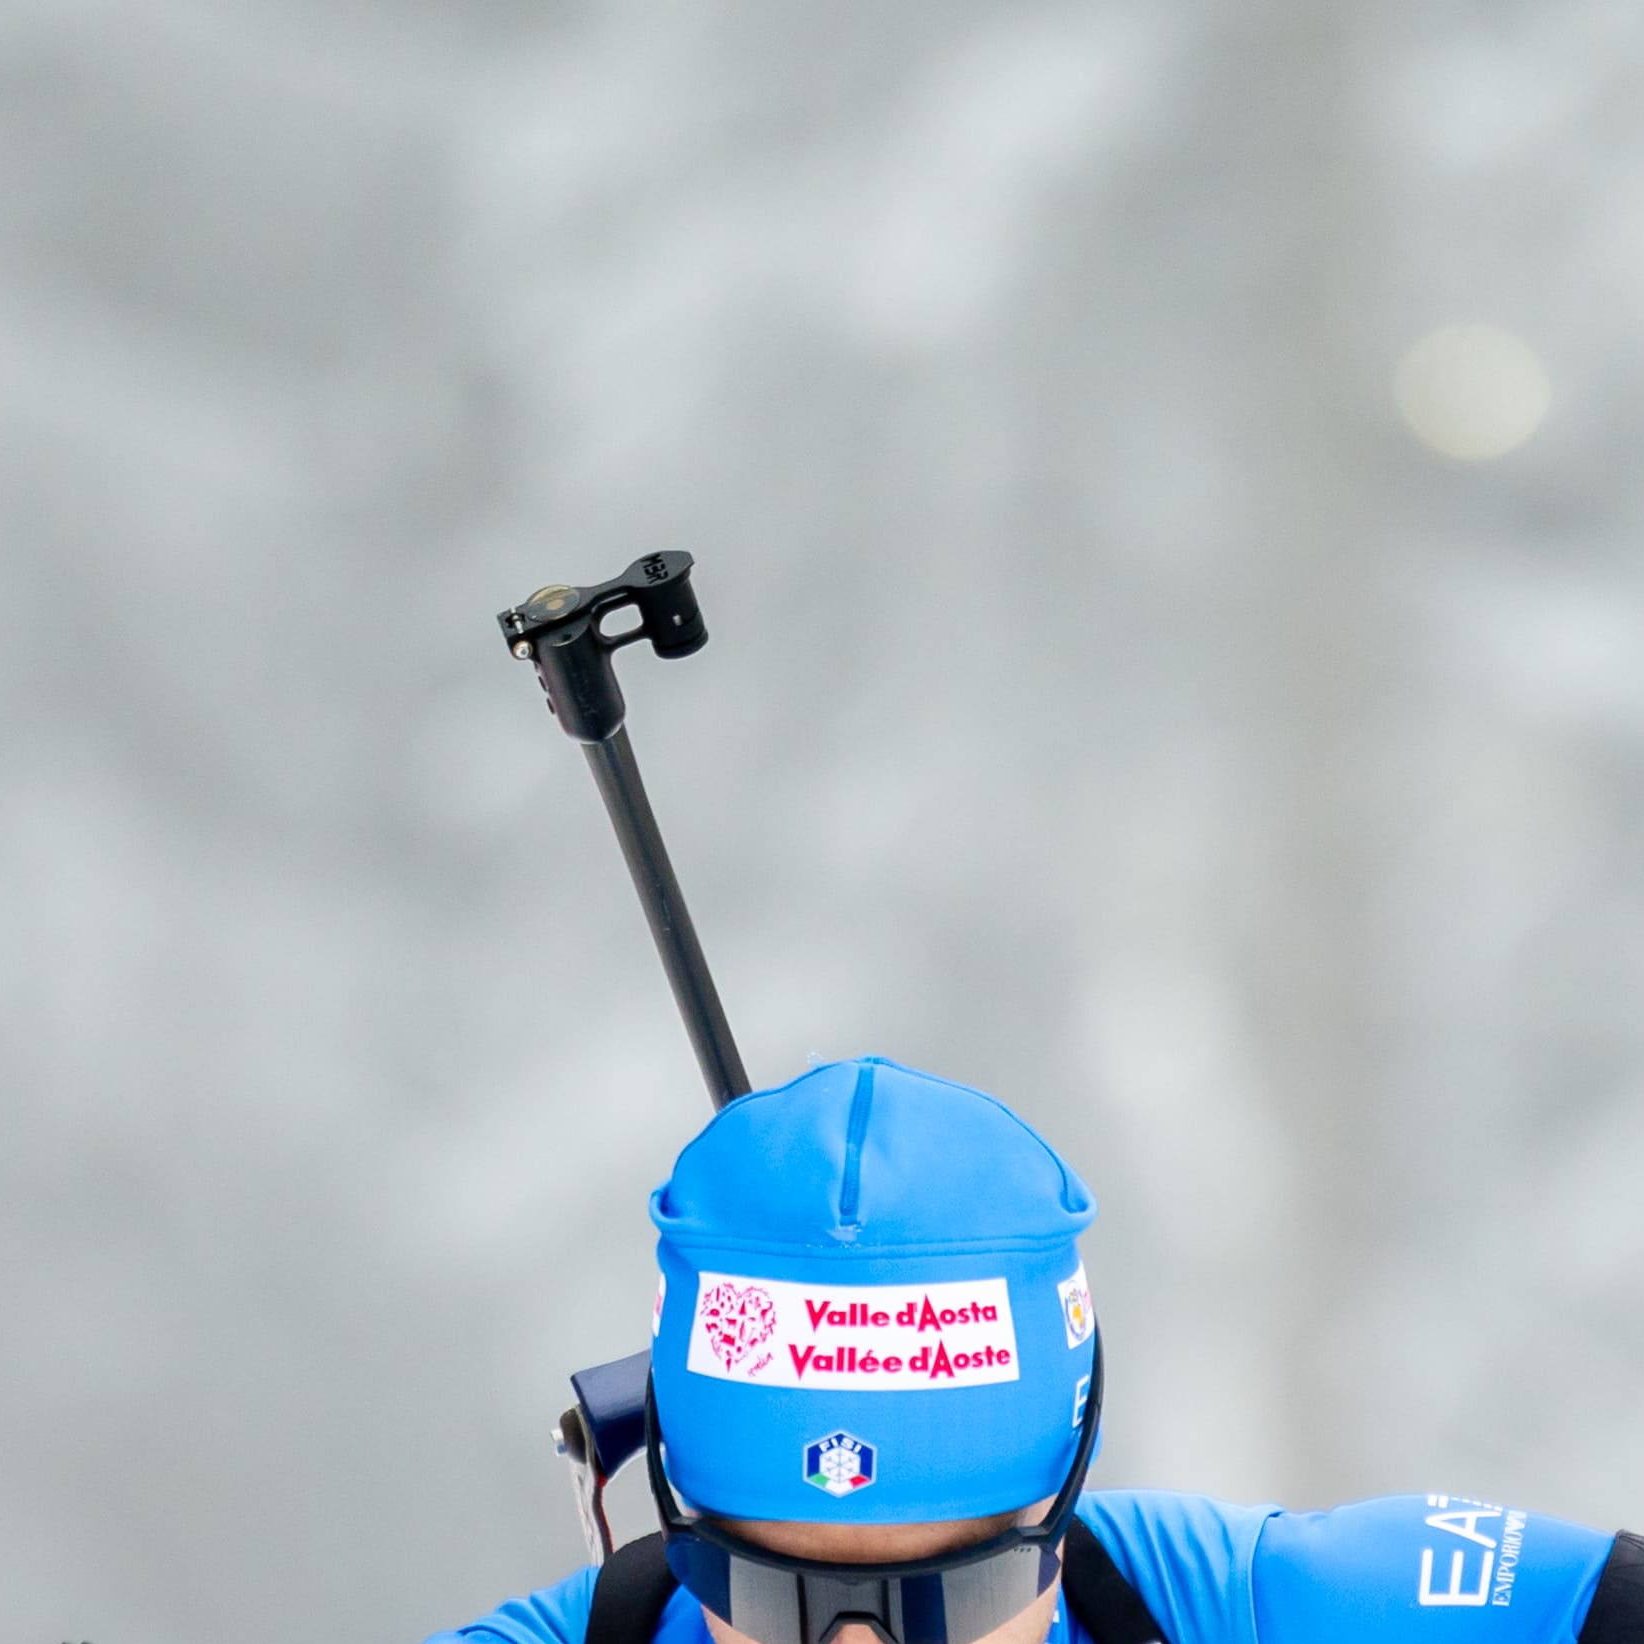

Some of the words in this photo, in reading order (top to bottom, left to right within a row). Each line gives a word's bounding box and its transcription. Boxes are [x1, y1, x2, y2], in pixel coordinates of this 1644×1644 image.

[804, 1299, 890, 1333] Valle
[788, 1343, 903, 1381] Vallée
[819, 1437, 862, 1454] FISI
